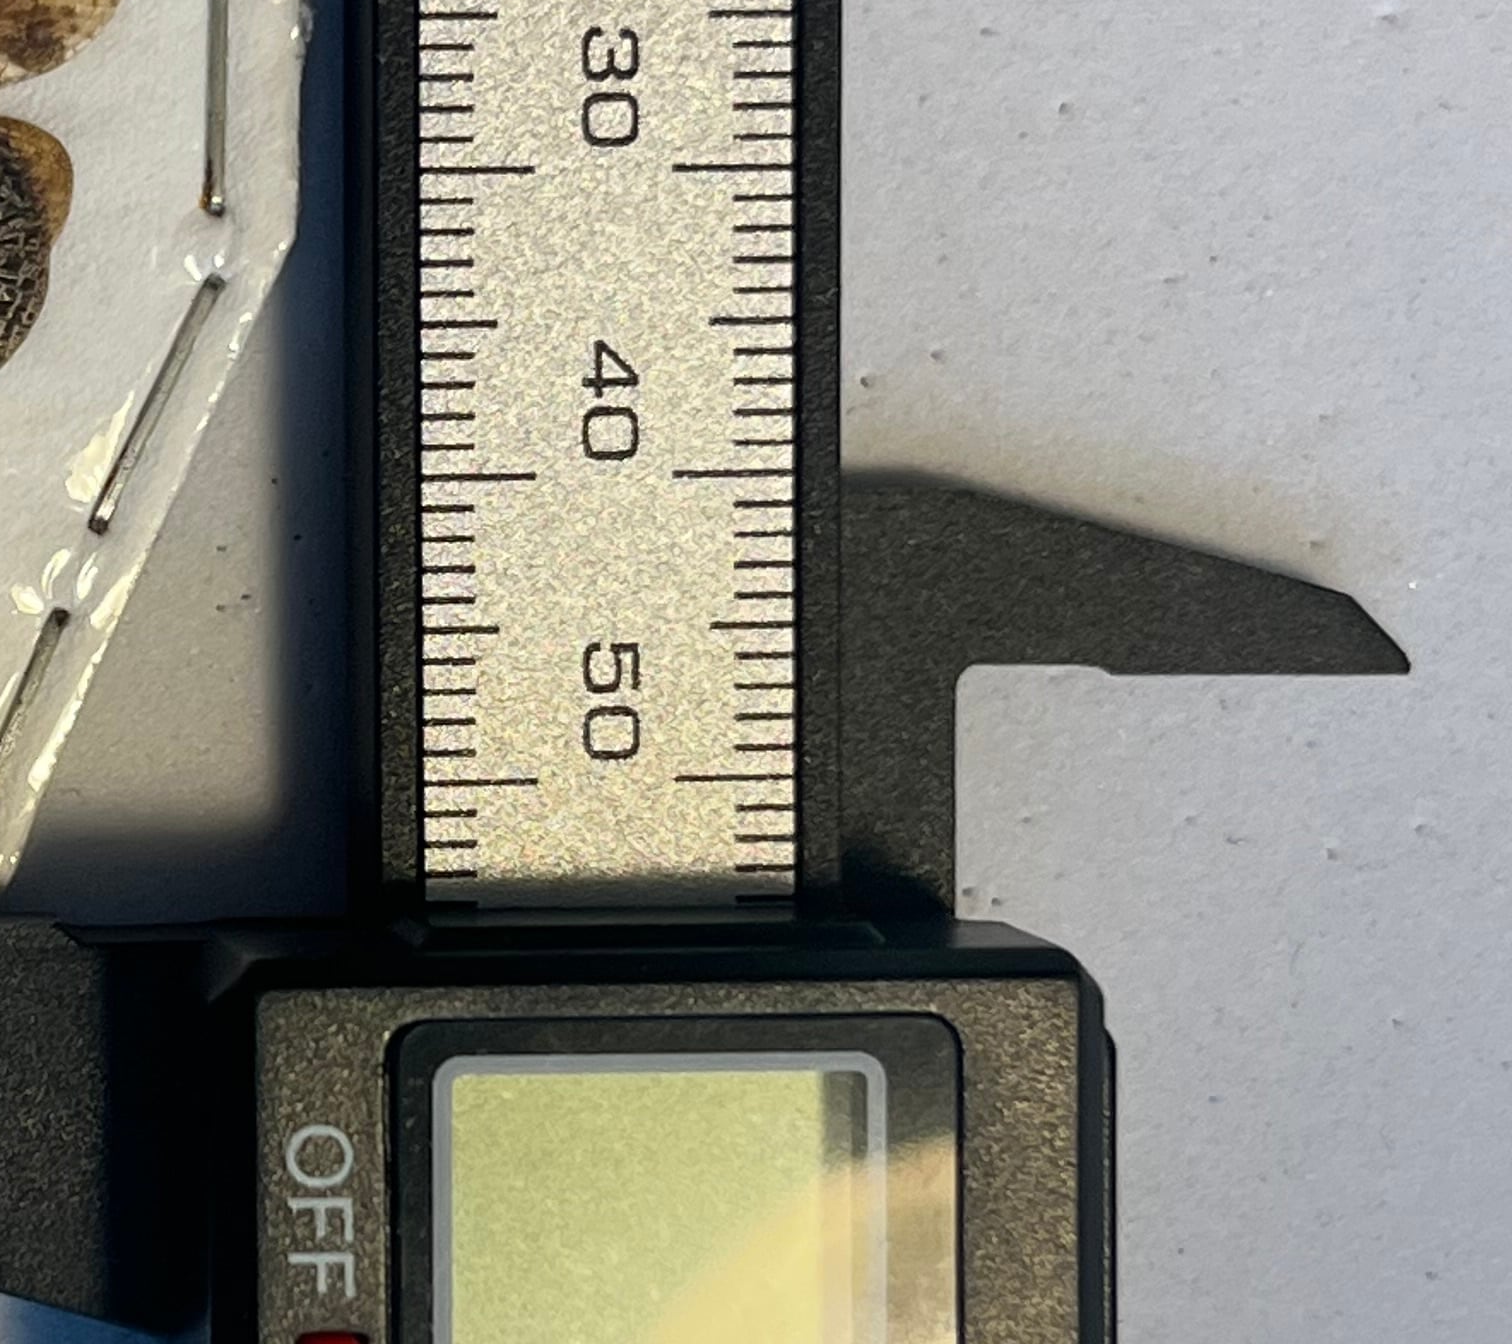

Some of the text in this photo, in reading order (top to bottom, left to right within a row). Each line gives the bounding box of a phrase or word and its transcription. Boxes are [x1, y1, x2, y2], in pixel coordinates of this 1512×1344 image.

[579, 24, 643, 150] 30
[579, 338, 643, 464] 40
[580, 639, 643, 764] 50
[285, 1124, 356, 1300] OFF
